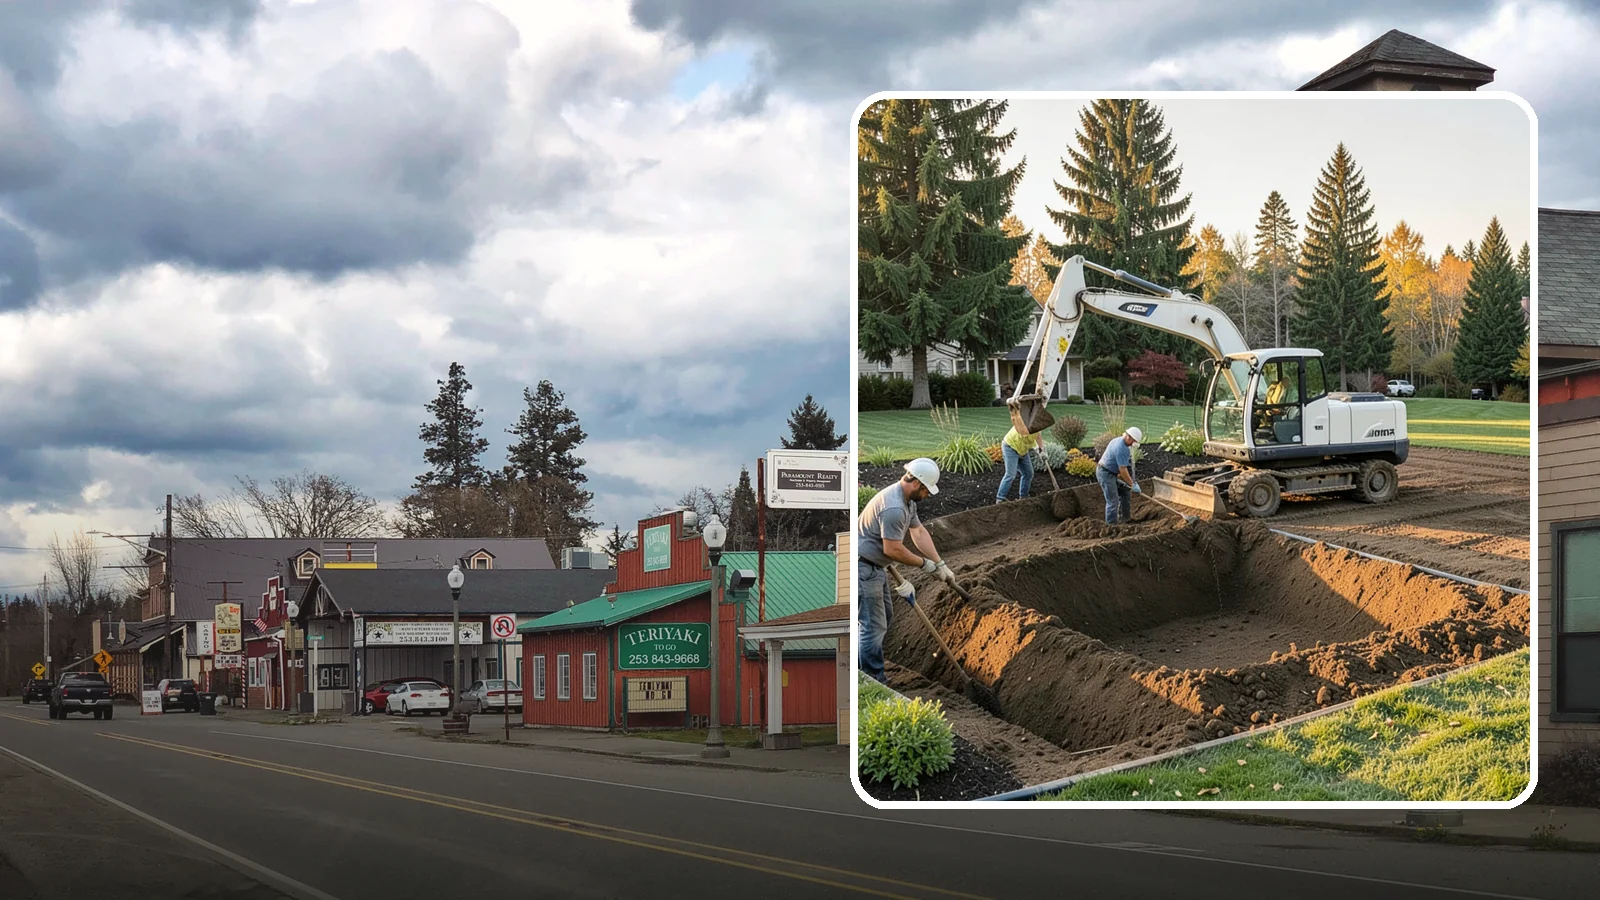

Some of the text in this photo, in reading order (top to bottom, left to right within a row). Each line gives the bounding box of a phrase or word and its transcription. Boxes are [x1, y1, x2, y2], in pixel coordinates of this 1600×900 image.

[781, 471, 839, 480] PARAMOUNT REALTY
[624, 627, 702, 646] TERIYAKI
[628, 654, 700, 665] 253 843-9668
